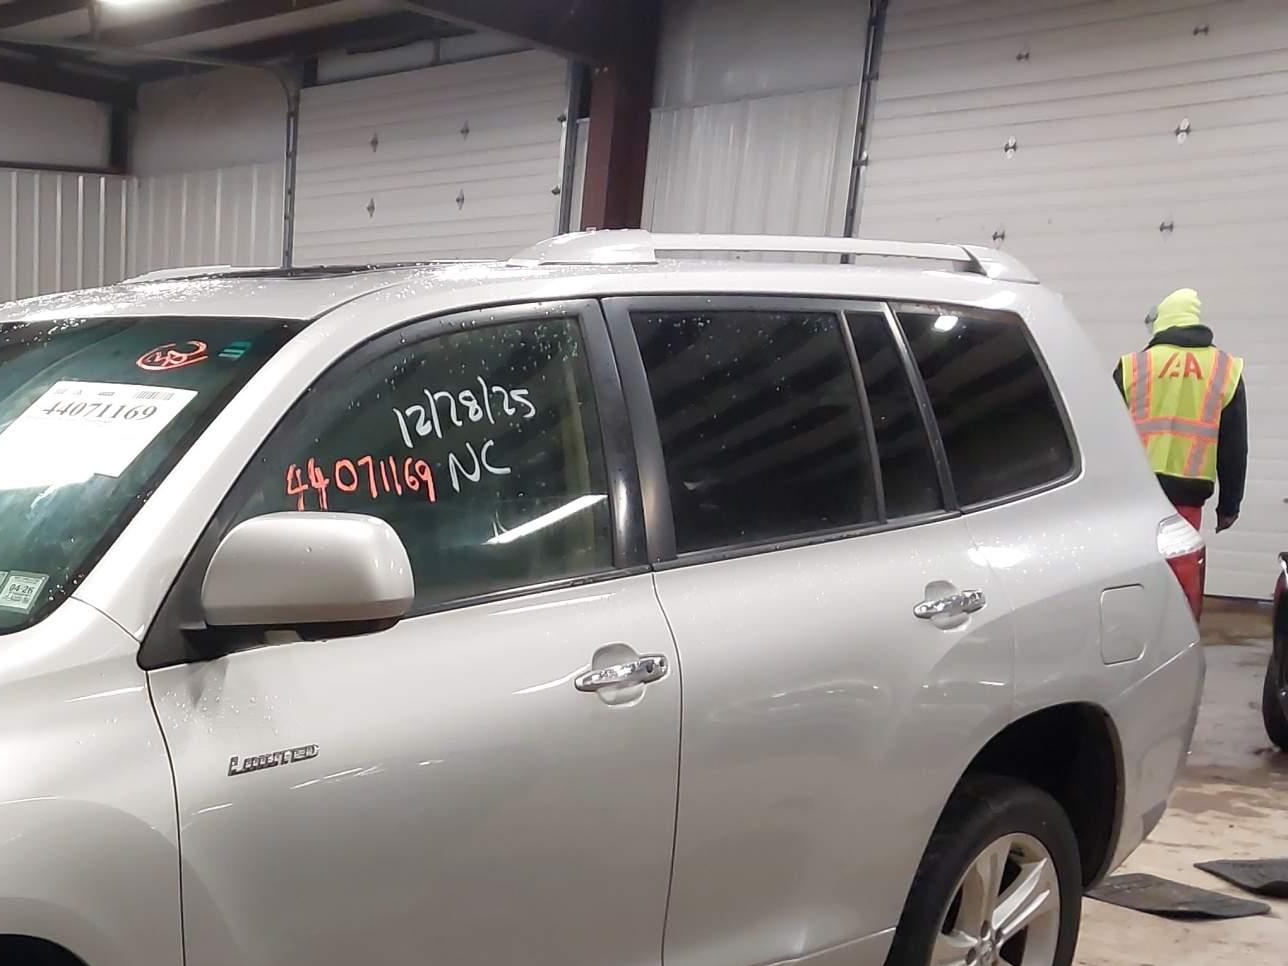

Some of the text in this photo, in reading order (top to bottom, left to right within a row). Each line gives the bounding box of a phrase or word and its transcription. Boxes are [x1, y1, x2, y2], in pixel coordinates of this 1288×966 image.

[42, 400, 158, 420] 44071169
[392, 375, 536, 449] 12/28/25
[285, 456, 436, 512] 44071169
[448, 439, 511, 493] NC
